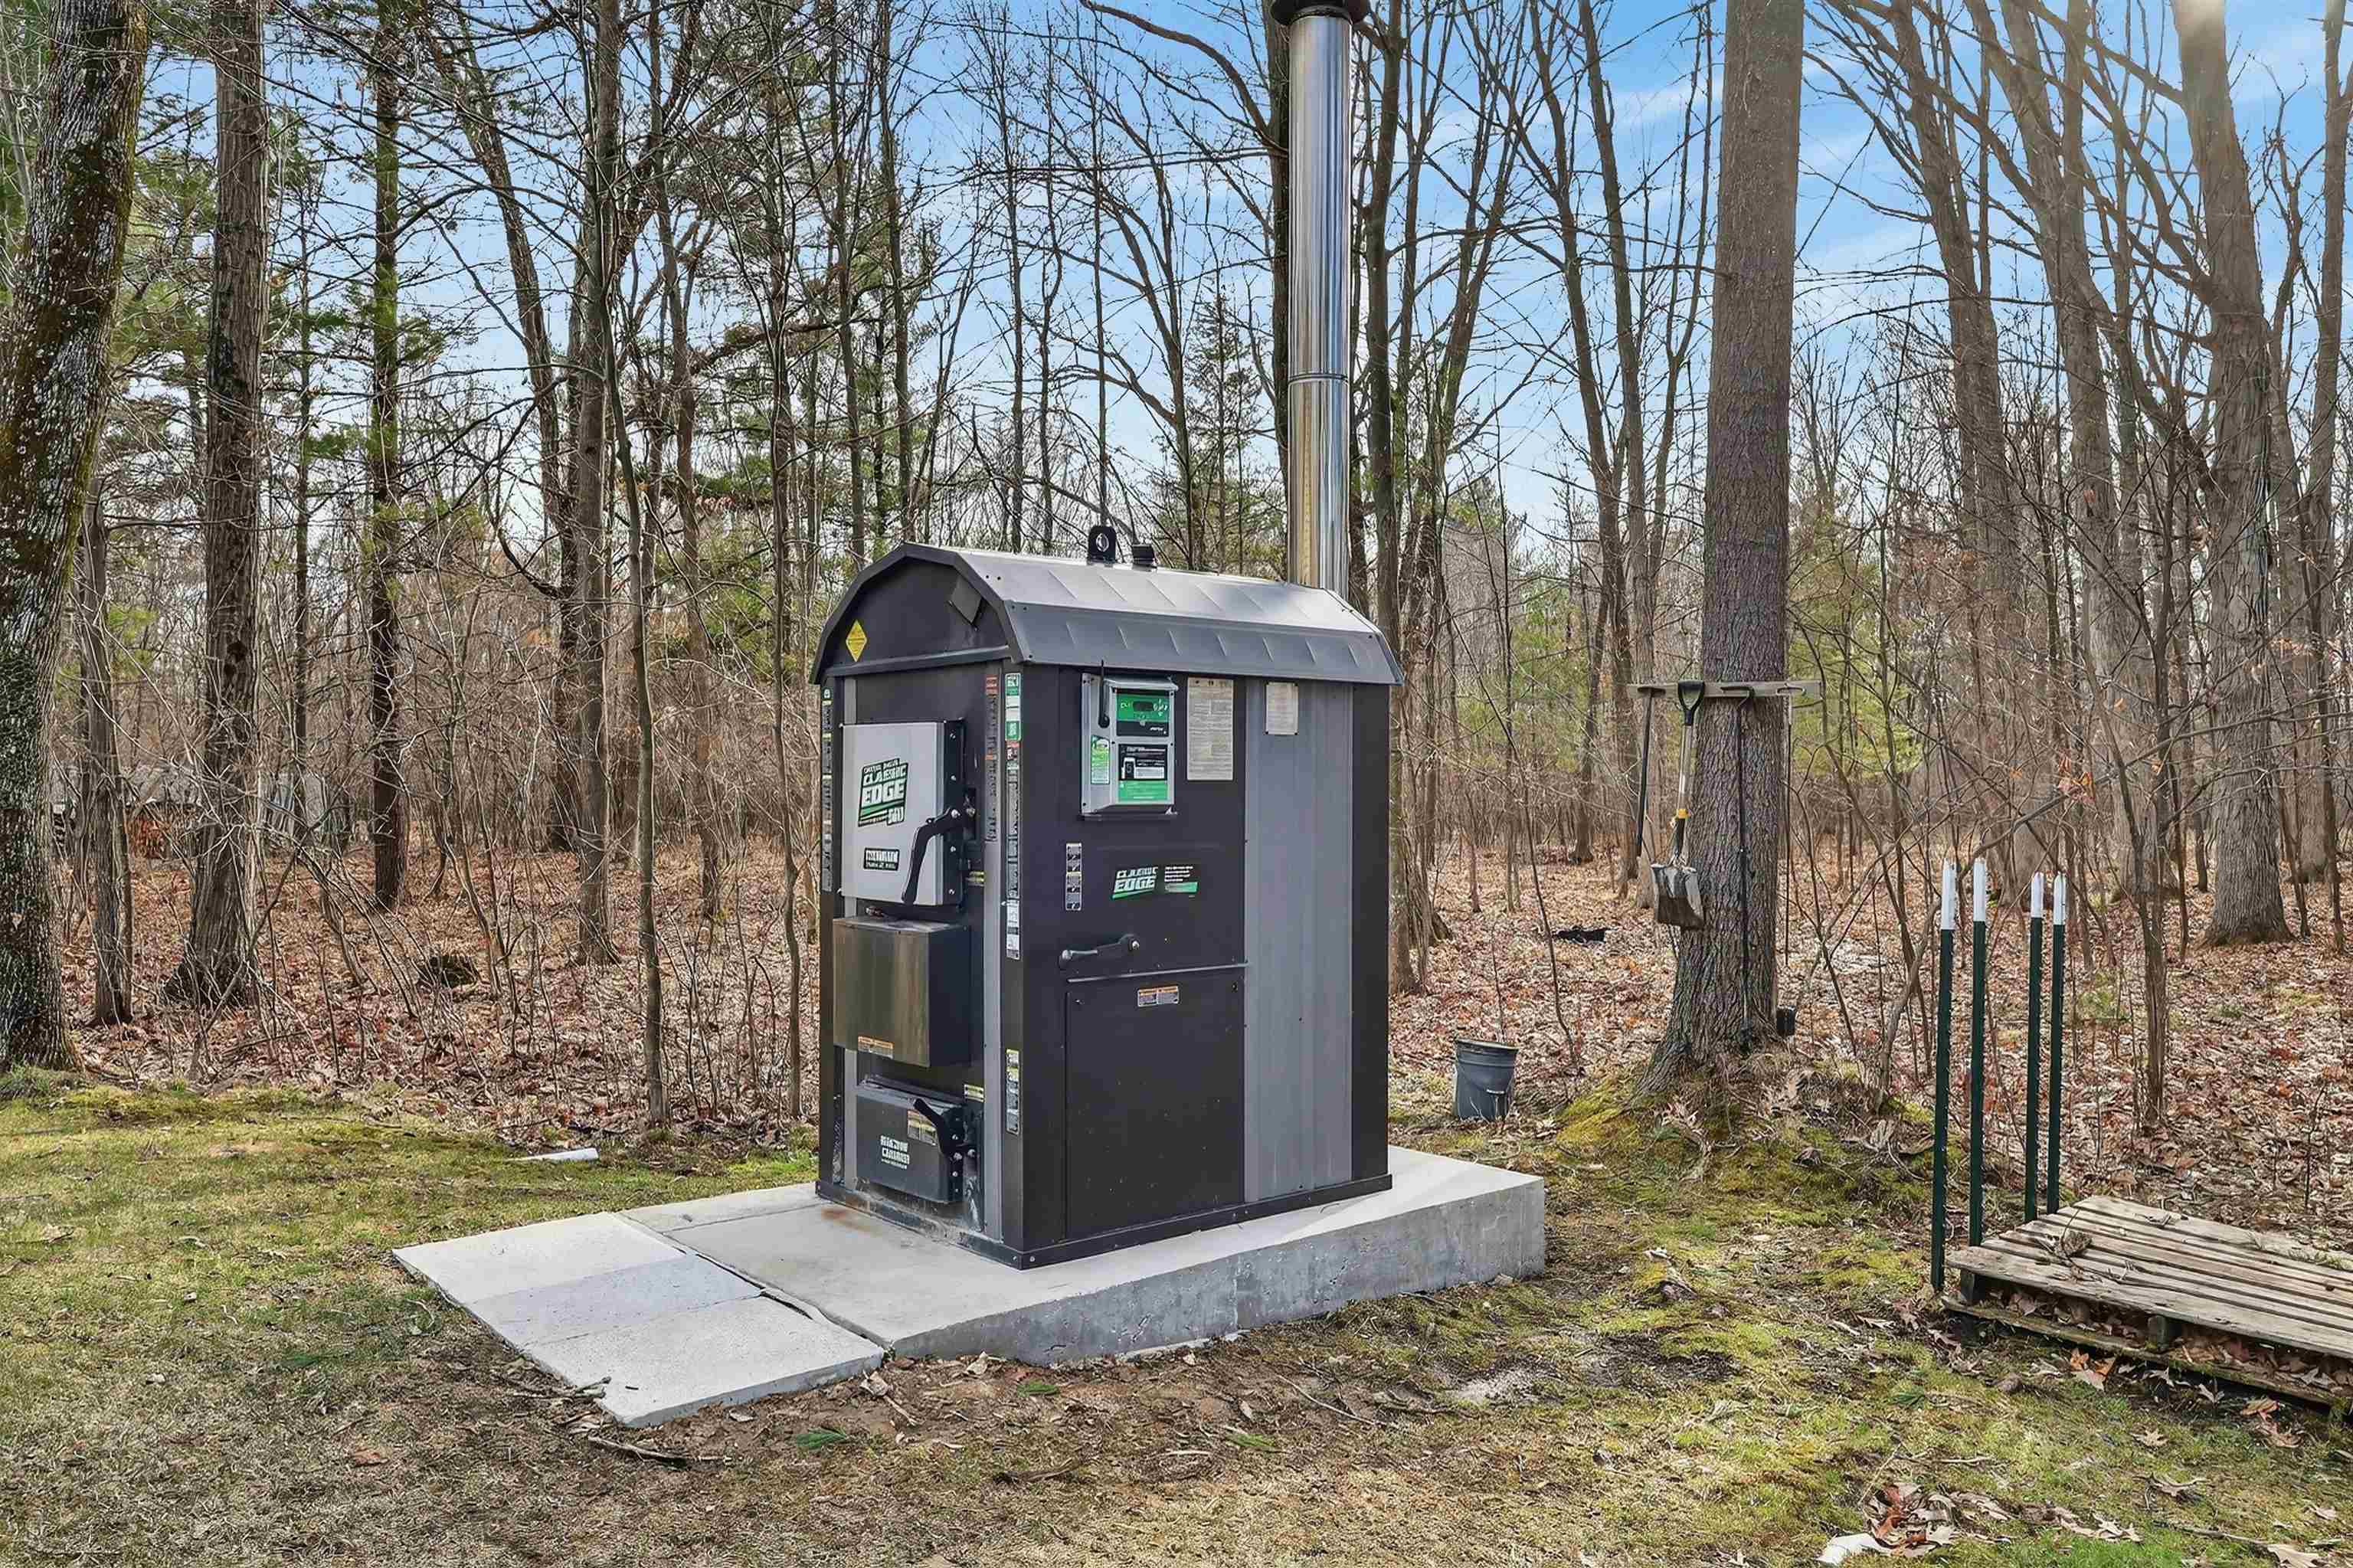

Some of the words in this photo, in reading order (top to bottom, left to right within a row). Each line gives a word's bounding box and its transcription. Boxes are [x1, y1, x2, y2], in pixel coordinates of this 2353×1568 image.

[862, 764, 907, 786] CLASSIC
[861, 779, 906, 807] EDGE
[1114, 875, 1157, 893] EDGE
